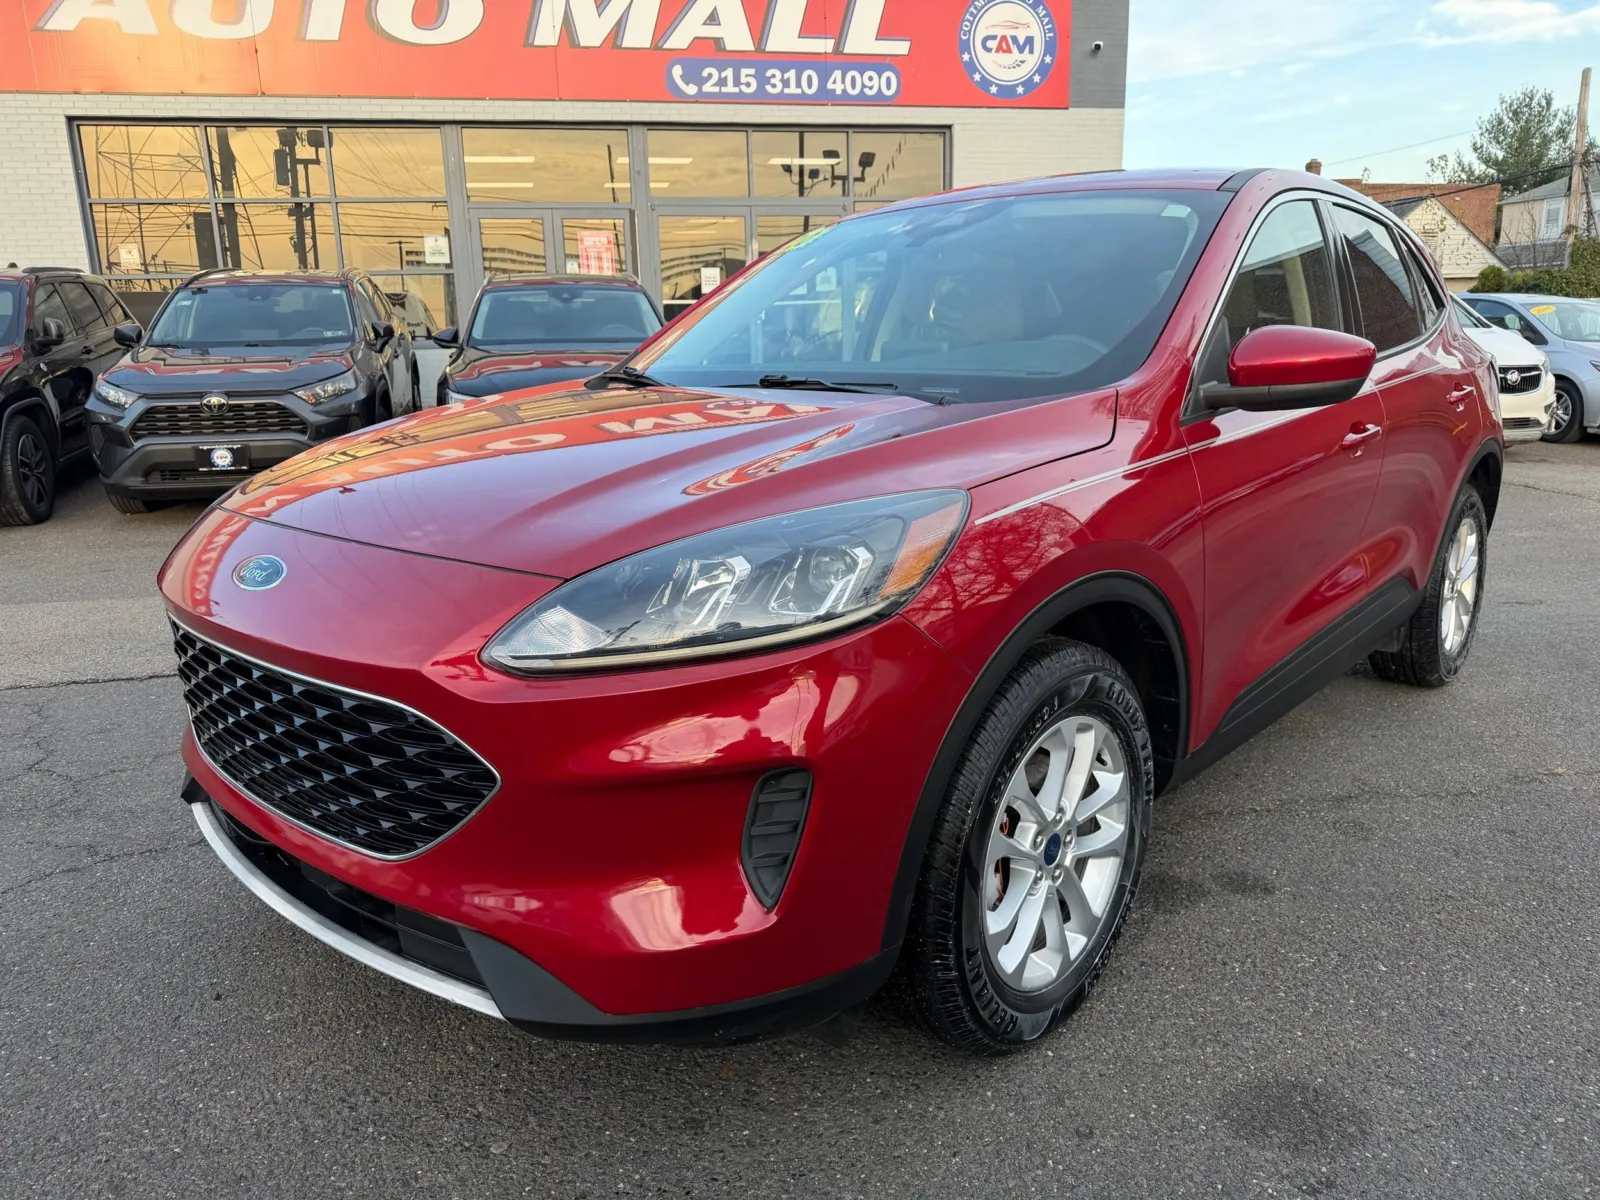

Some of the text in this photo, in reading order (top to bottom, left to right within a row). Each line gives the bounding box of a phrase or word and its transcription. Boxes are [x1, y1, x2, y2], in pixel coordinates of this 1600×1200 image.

[523, 0, 913, 56] MALL
[1035, 5, 1054, 40] MALL
[981, 35, 1035, 54] CAM
[701, 67, 898, 96] 215 310 4090
[964, 945, 1020, 1036] RELIANT
